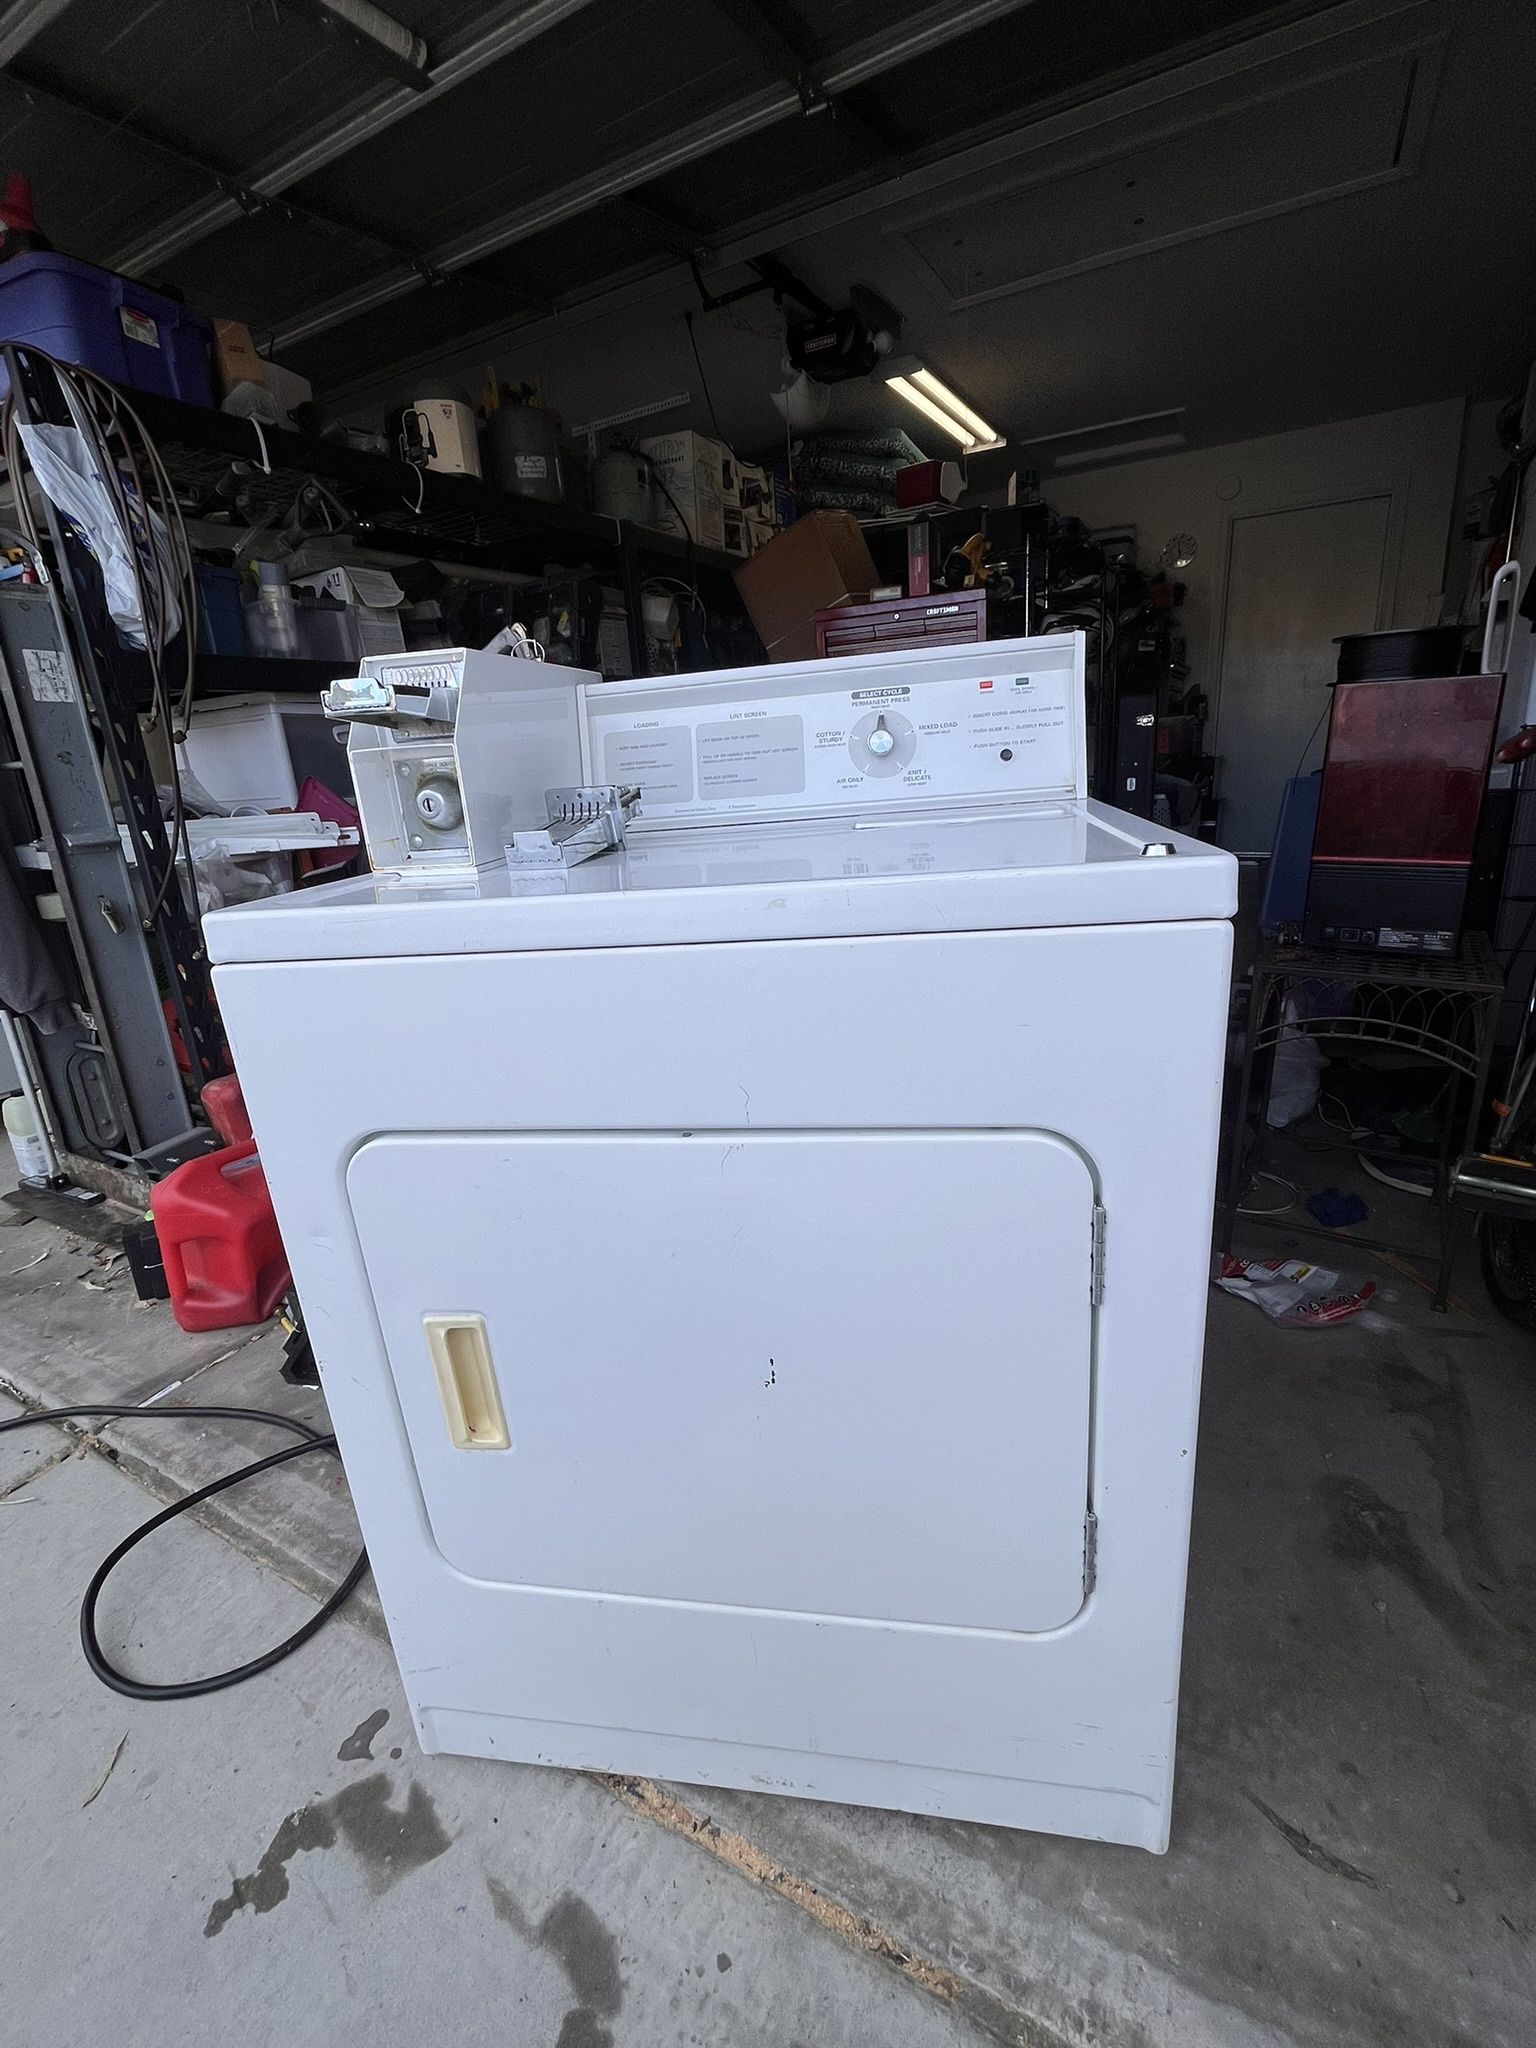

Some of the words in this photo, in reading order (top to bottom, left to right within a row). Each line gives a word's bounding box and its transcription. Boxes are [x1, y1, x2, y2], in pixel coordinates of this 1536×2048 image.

[926, 605, 959, 615] CRAFTSMAN
[859, 690, 881, 698] SELECT
[882, 688, 902, 696] CYCLE
[851, 698, 889, 708] PERMANENT
[890, 696, 910, 704] PRESS
[730, 712, 742, 720] LINT
[634, 721, 659, 729] LOADING
